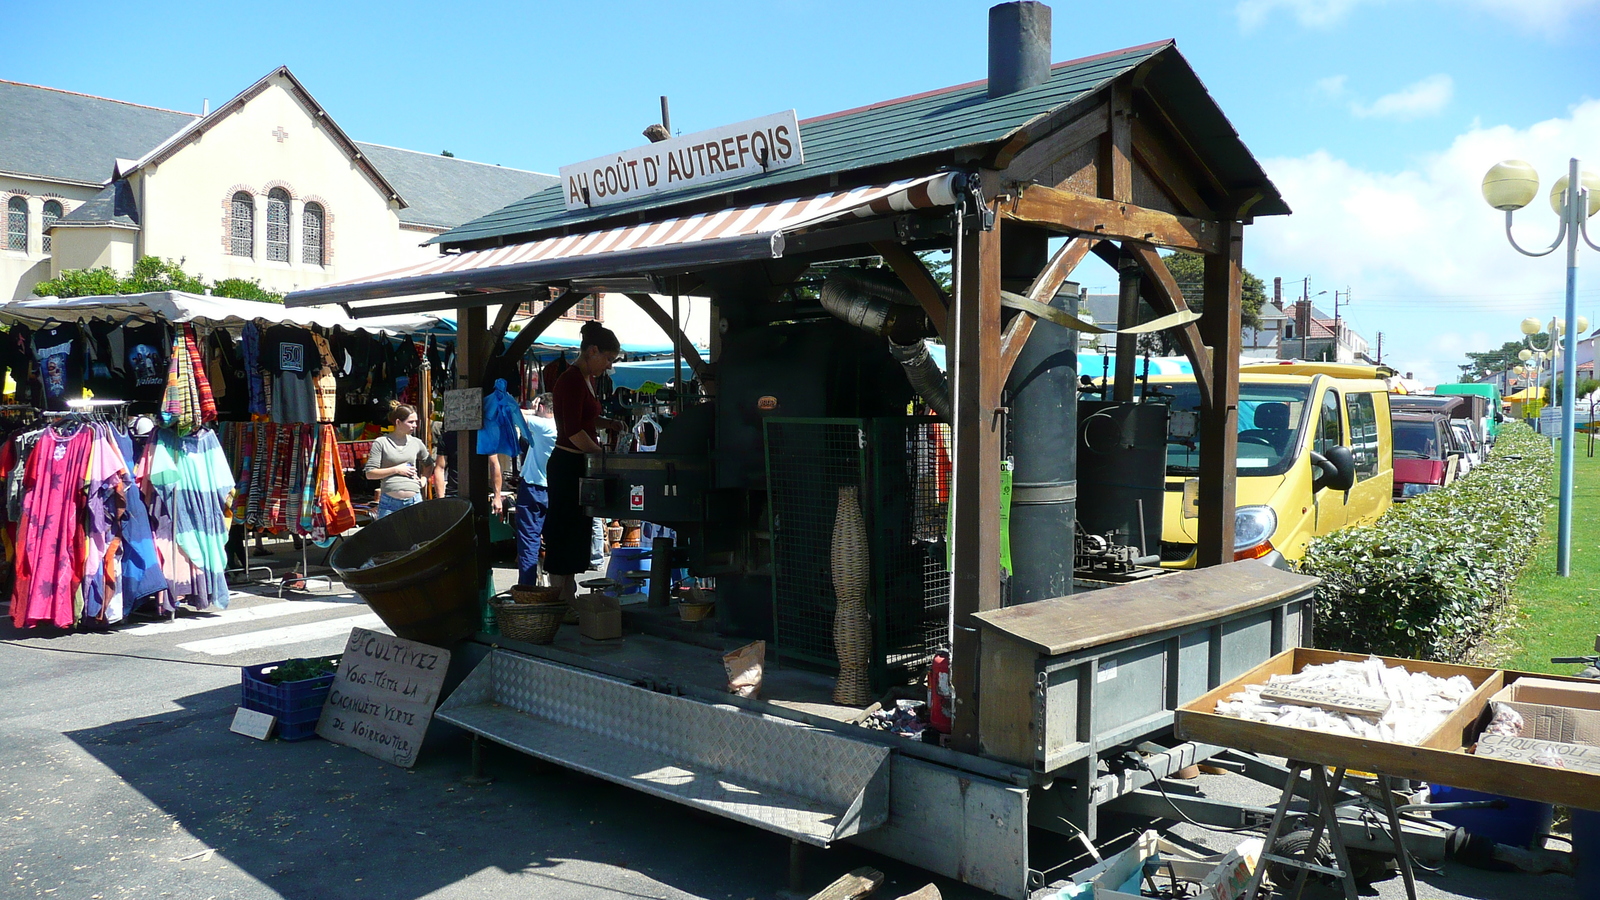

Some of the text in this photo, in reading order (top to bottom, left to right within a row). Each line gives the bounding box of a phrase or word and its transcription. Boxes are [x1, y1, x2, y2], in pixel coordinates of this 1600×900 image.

[568, 125, 793, 204] AU GOÛT D' AUTREFOIS
[402, 677, 418, 697] LA
[332, 718, 346, 730] DE
[384, 703, 415, 725] VERTE
